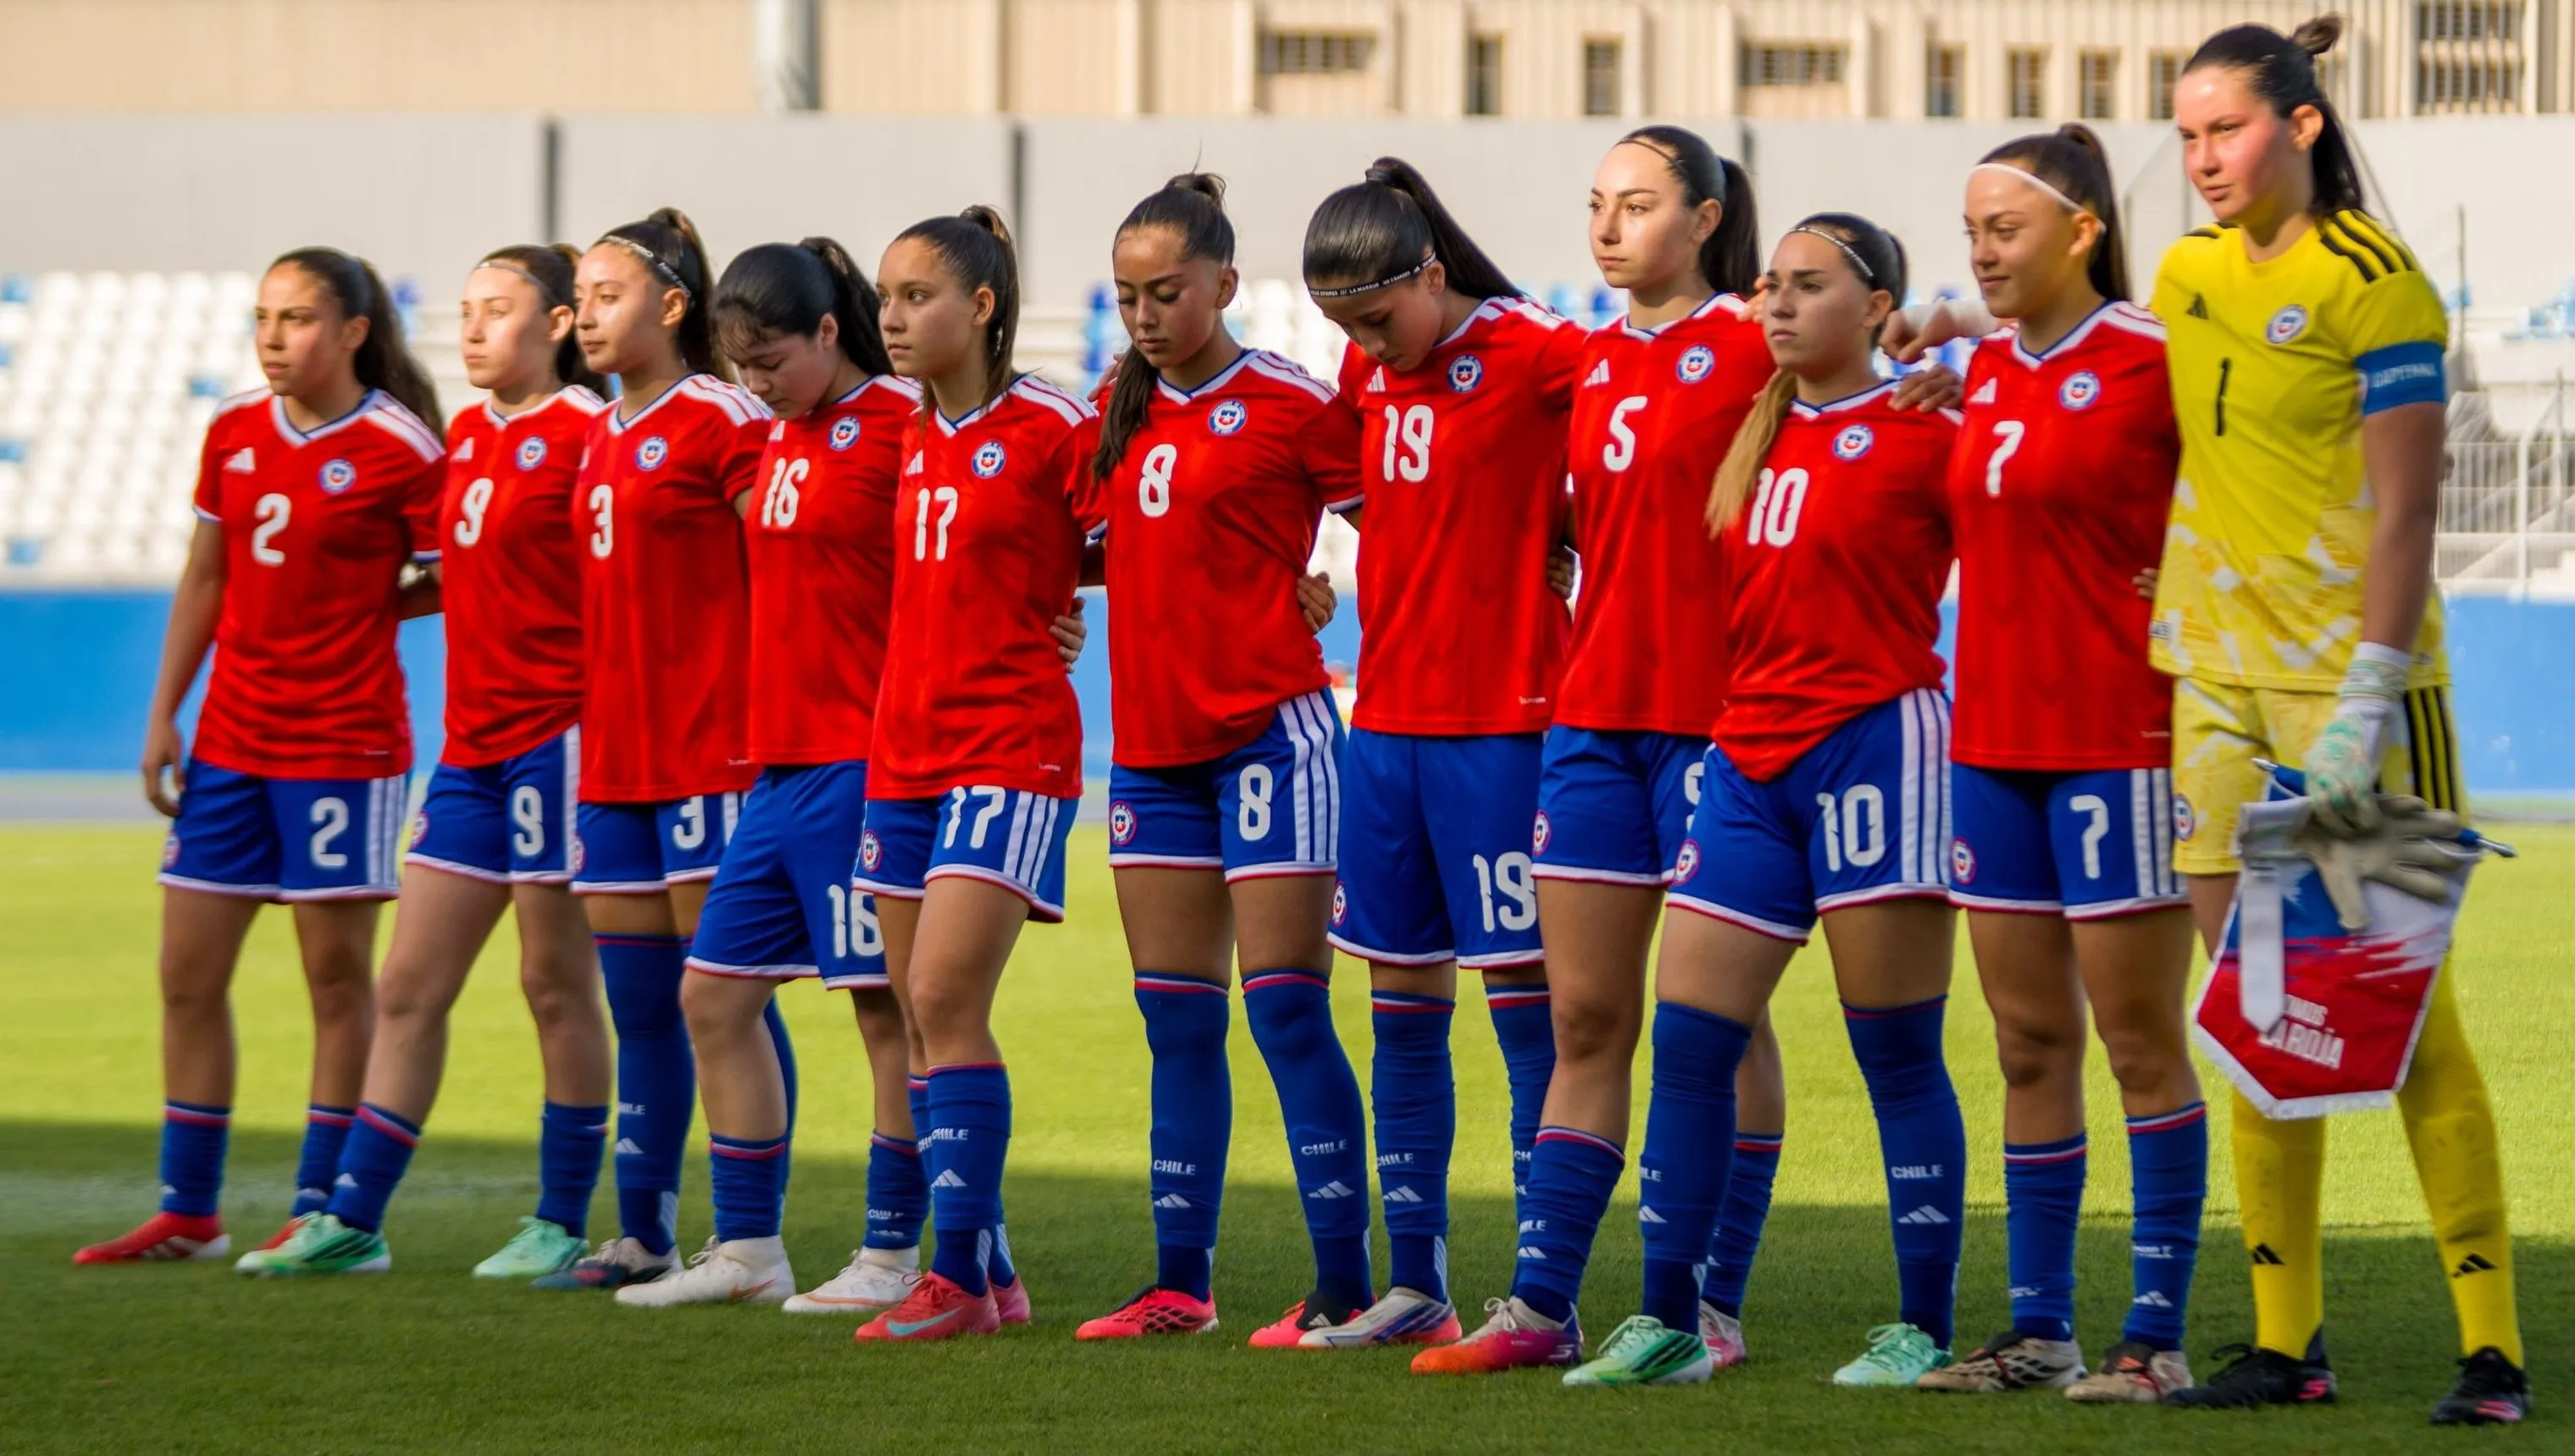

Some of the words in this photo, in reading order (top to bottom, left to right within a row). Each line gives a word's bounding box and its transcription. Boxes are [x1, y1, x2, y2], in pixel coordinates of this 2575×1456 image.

[2216, 357, 2231, 436] 1
[1382, 403, 1435, 483] 19
[1603, 395, 1648, 473] 5
[1985, 419, 2025, 495] 7
[455, 477, 494, 546] 9
[761, 457, 811, 529] 16
[1138, 442, 1178, 518] 8
[1747, 467, 1809, 548] 10
[252, 492, 291, 565] 2
[589, 484, 613, 558] 3
[915, 485, 960, 562] 17
[311, 796, 348, 868] 2
[512, 784, 545, 857] 9
[673, 794, 706, 850] 3
[943, 783, 1007, 850] 17
[1238, 763, 1274, 842] 8
[1817, 783, 1886, 872] 10
[2070, 794, 2108, 879] 7
[828, 883, 885, 958] 16
[1473, 850, 1537, 933] 19
[931, 1127, 969, 1141] CHILE
[1153, 1159, 1196, 1176] CHILE
[1300, 1139, 1347, 1155] CHILE
[1891, 1164, 1944, 1179] CHILE
